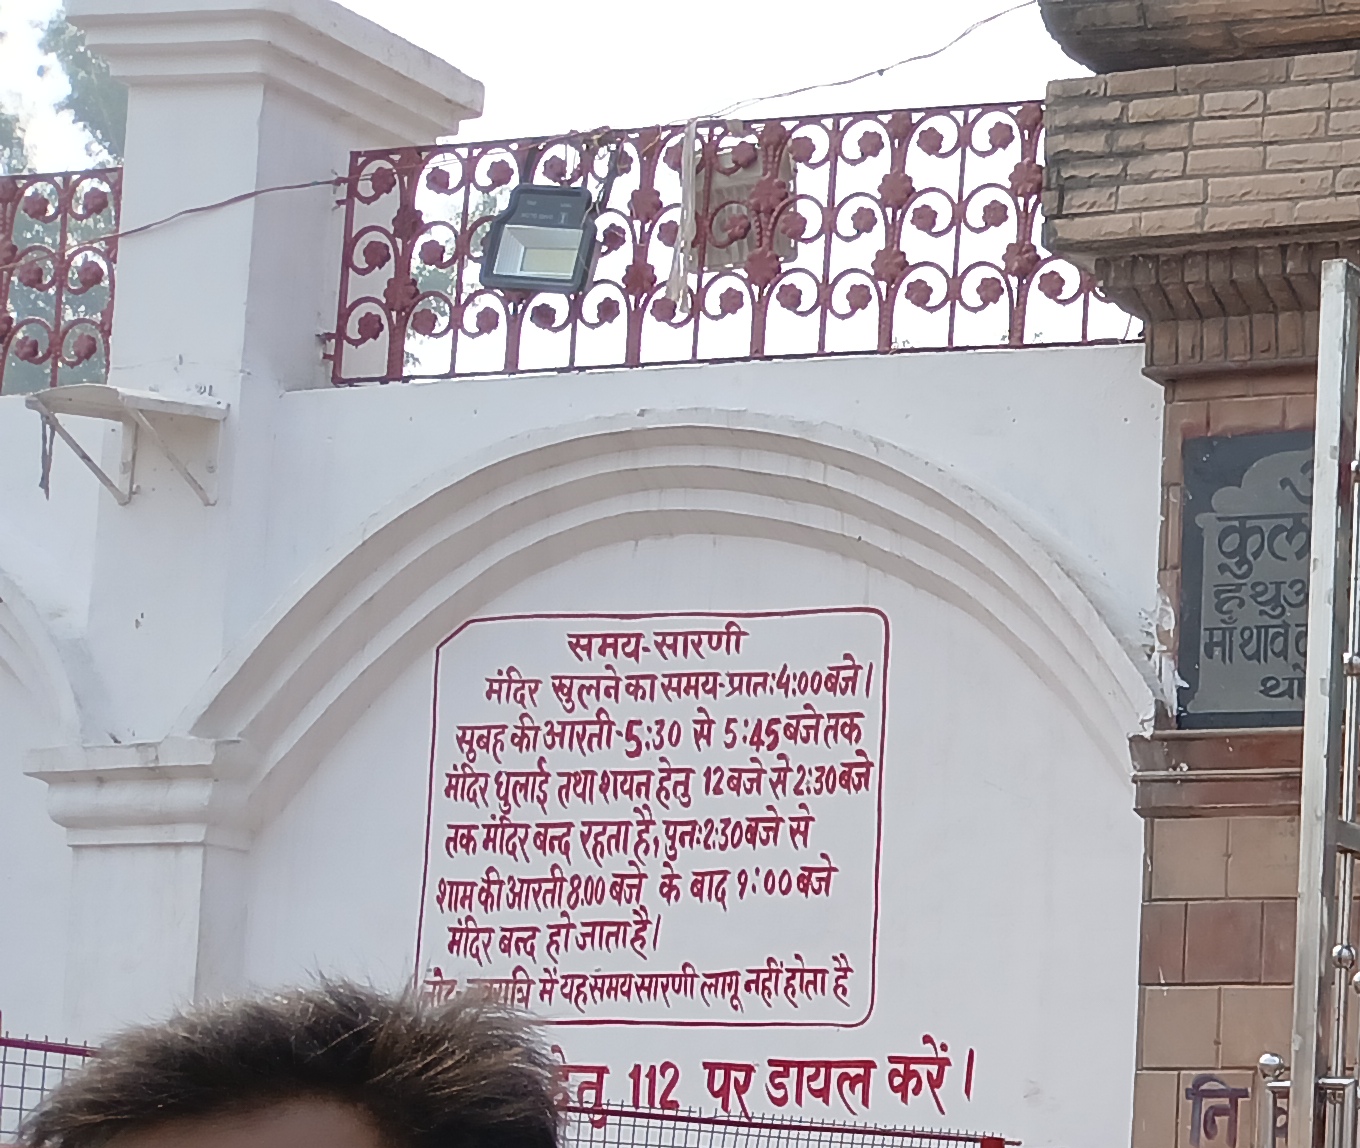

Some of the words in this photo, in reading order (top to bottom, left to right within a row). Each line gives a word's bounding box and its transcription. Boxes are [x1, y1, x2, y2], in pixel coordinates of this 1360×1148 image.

[484, 664, 544, 710] मंदिर
[455, 723, 509, 765] सुबह
[510, 712, 542, 754] की
[691, 705, 717, 752] से
[444, 761, 492, 810] मंदिर
[493, 755, 552, 816] धुलाई
[555, 769, 599, 810] तथा
[598, 769, 655, 805] शयन
[655, 755, 697, 811] हेतु
[768, 752, 795, 801] से
[445, 823, 480, 859] तक
[480, 813, 532, 864] मंदिर
[532, 821, 576, 867] बन्द
[579, 820, 634, 869] रहता
[788, 802, 817, 851] से
[435, 877, 478, 915] शाम
[477, 865, 506, 915] की
[506, 862, 568, 913] आरती
[608, 859, 649, 907] बजे
[658, 860, 683, 907] के
[689, 869, 732, 913] बाद
[796, 852, 840, 899] बजे
[447, 914, 496, 968] मंदिर
[498, 926, 542, 965] बन्द
[545, 910, 577, 965] हो
[538, 966, 560, 1007] में
[700, 970, 745, 1014] लागू
[743, 956, 784, 1009] नहीं
[783, 953, 830, 1009] होता
[832, 953, 855, 1008] है
[628, 1060, 681, 1111] 112
[702, 1060, 758, 1122] पर
[764, 1058, 878, 1116] डायल
